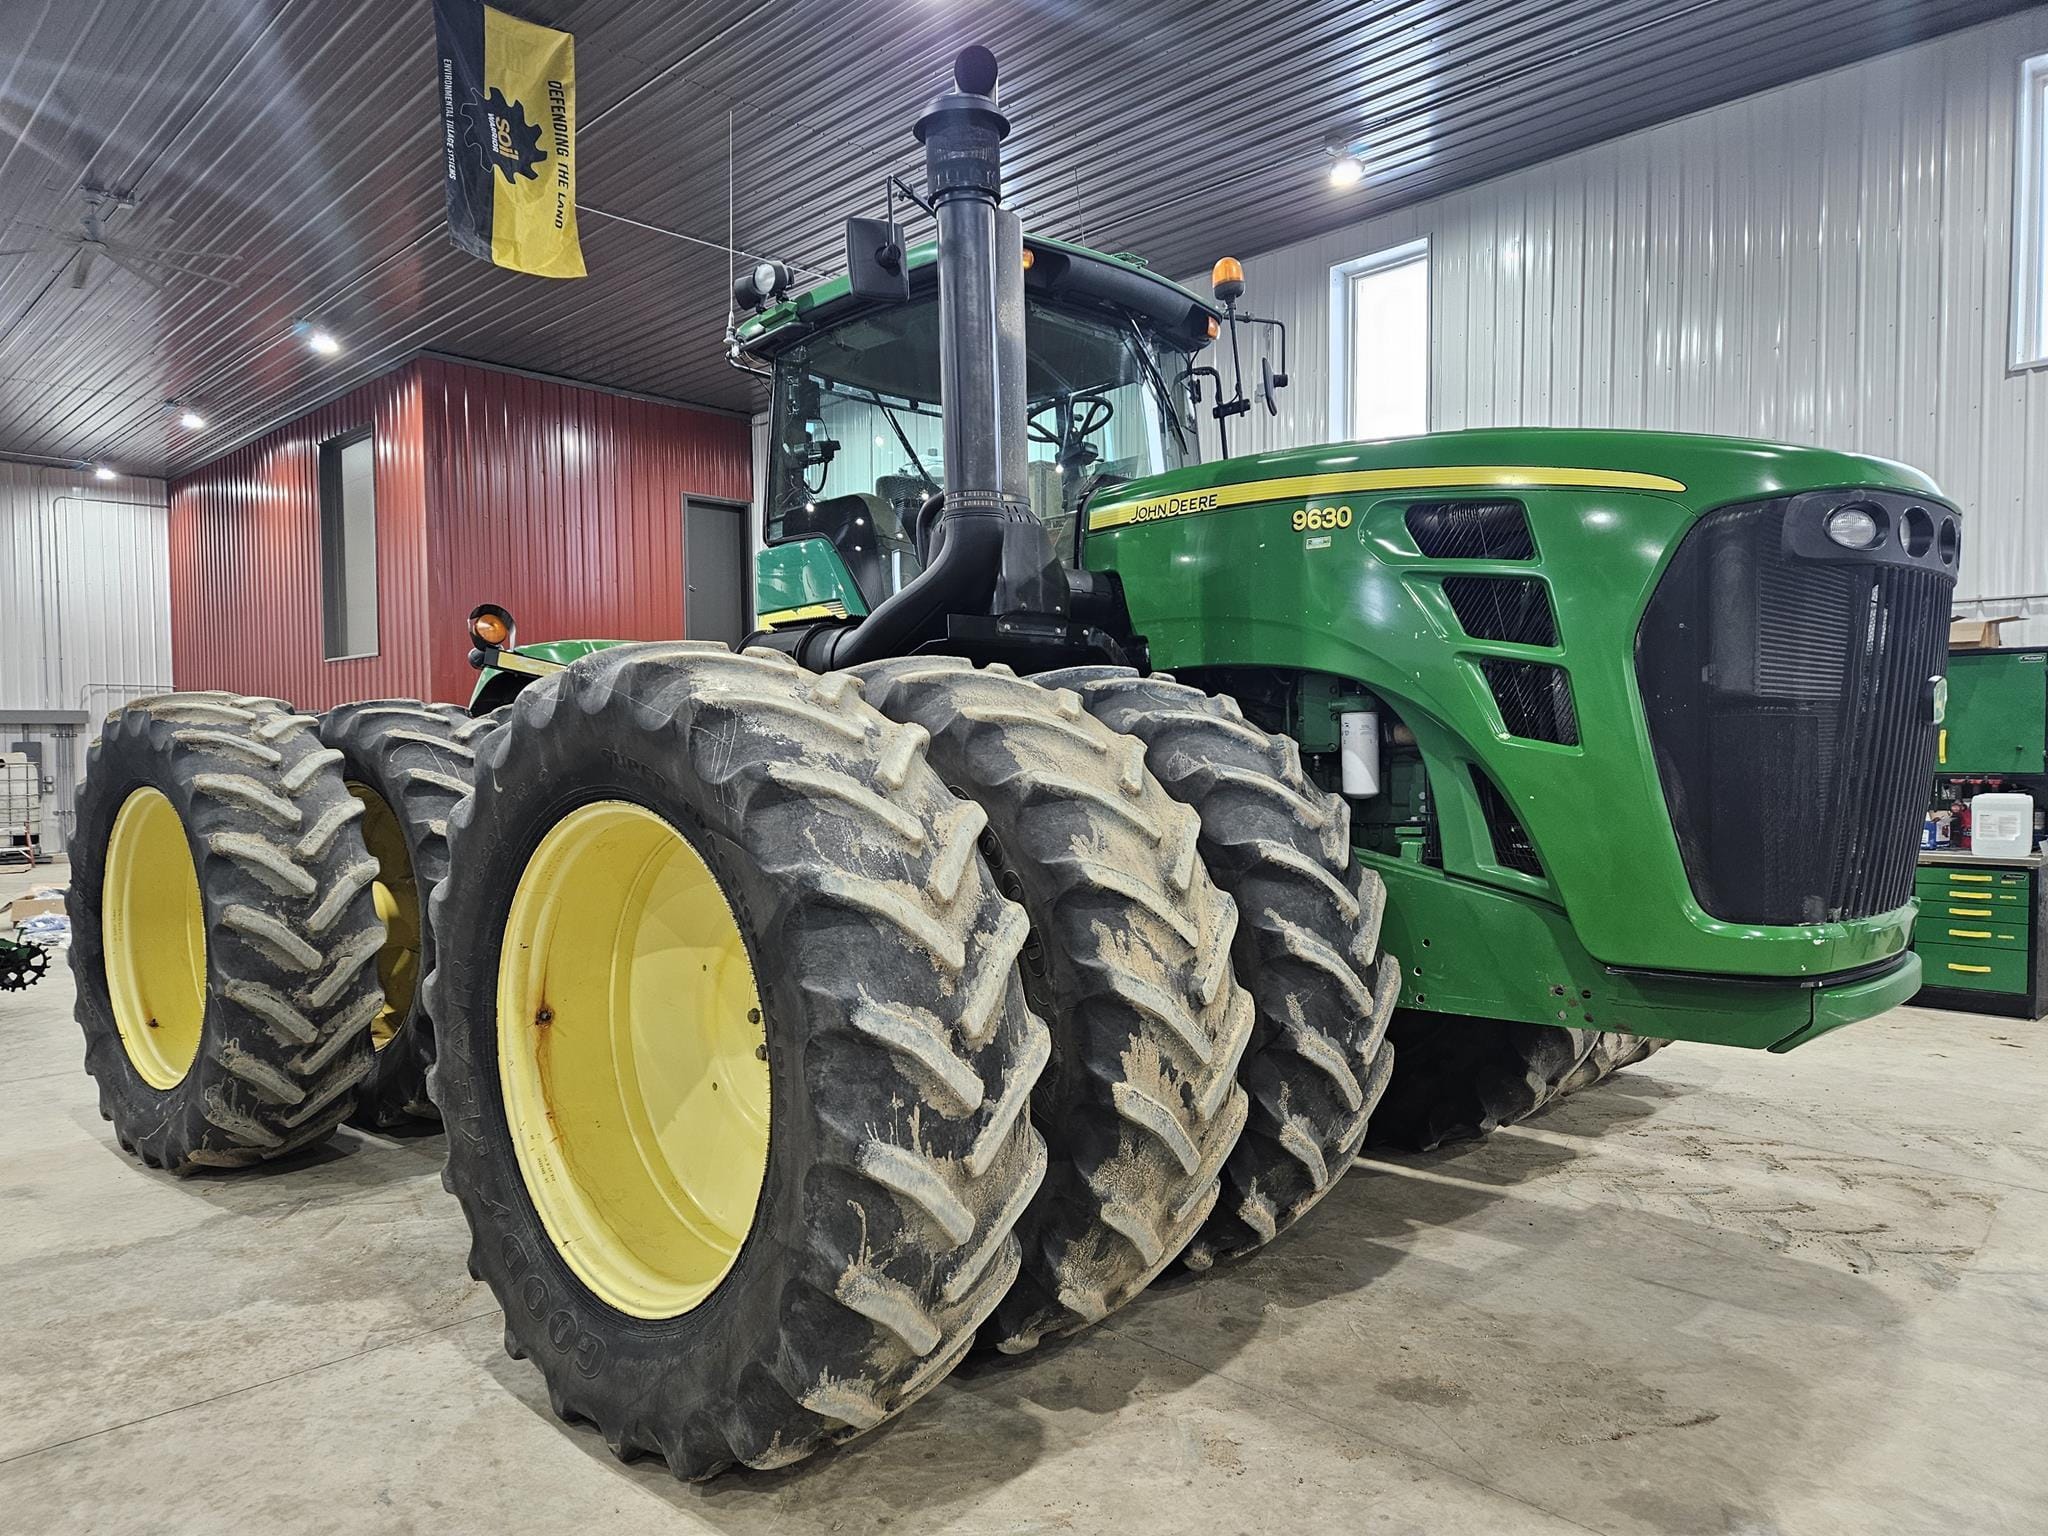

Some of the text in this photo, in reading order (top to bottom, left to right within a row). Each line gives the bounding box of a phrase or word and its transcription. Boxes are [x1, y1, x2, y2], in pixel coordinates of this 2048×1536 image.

[443, 59, 456, 180] ENVIRONMENTAL TILLAGE SYSTEMS
[488, 113, 499, 153] WARRIOR
[548, 80, 569, 229] DEFENDING THE LAND
[1130, 494, 1218, 523] JOHN DEERE
[1292, 505, 1353, 531] 9630
